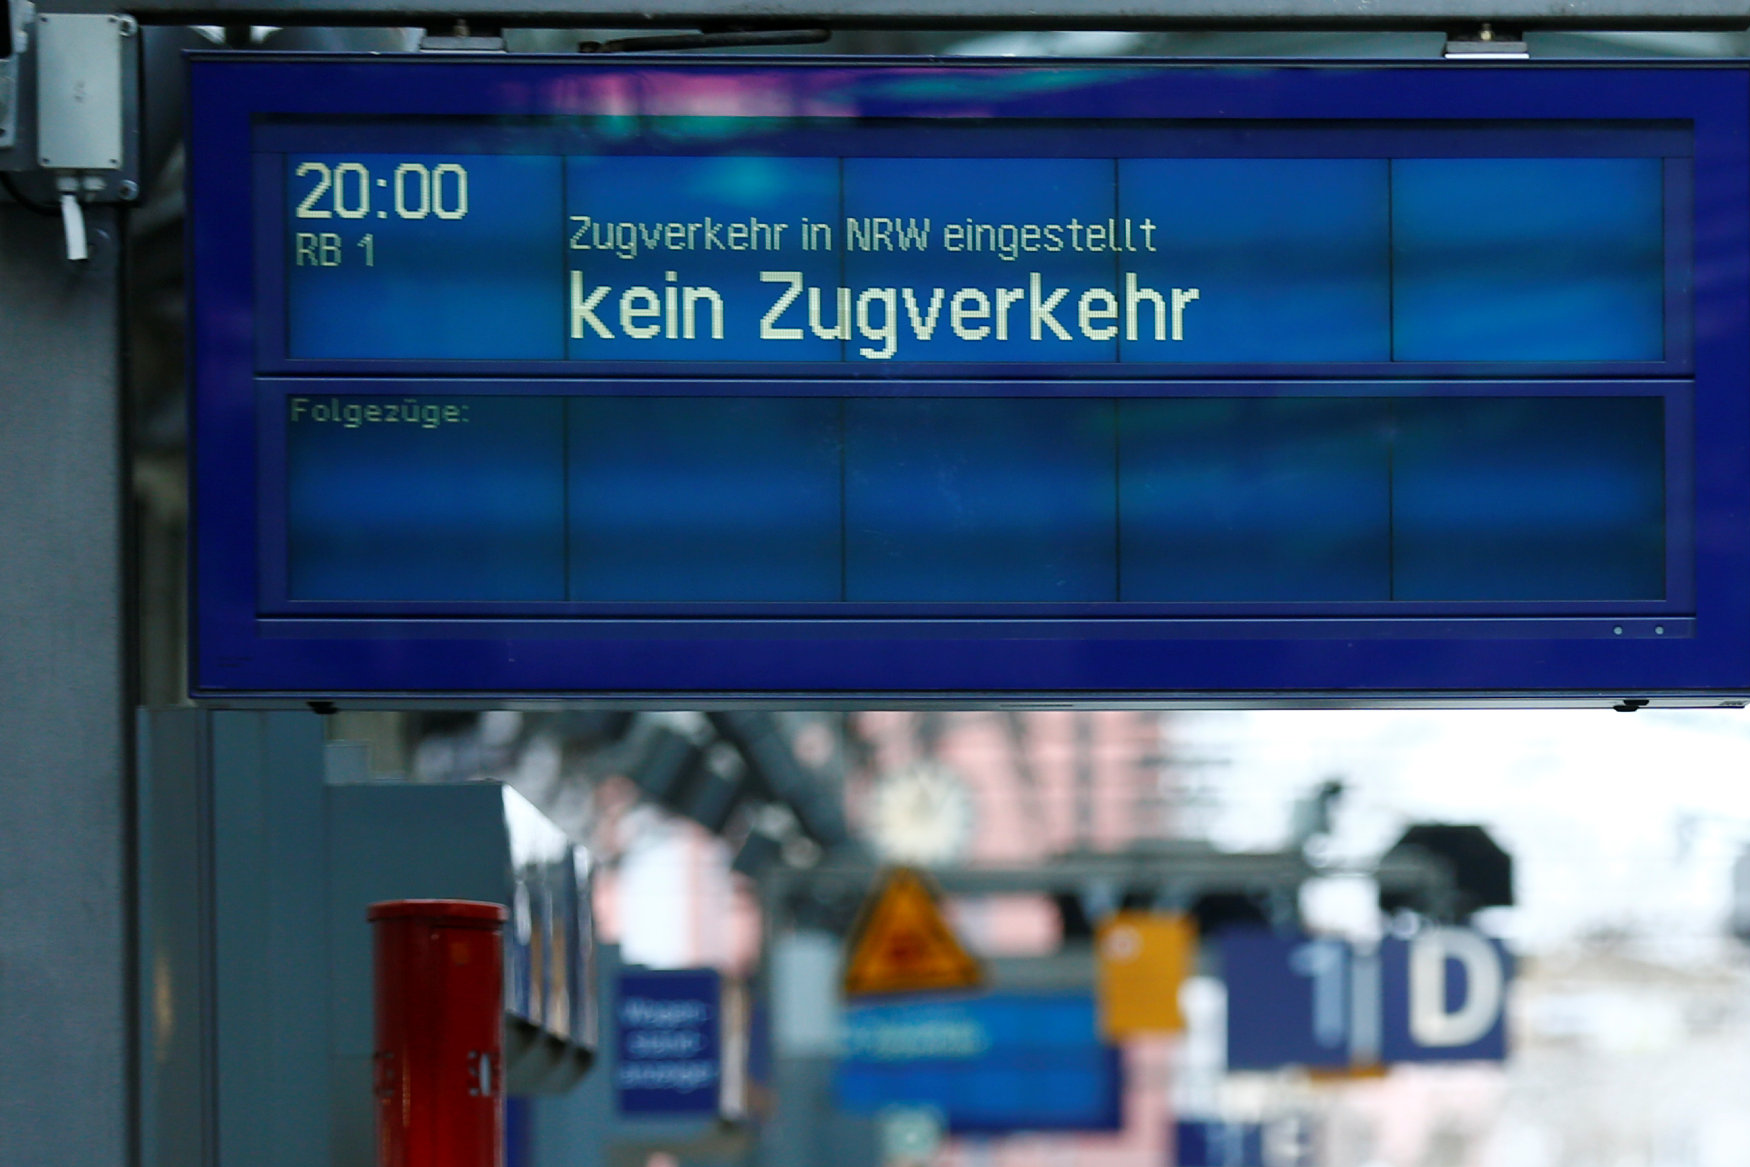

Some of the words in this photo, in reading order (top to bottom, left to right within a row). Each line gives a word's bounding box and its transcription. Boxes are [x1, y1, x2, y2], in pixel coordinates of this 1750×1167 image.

[296, 161, 468, 220] 20:00
[296, 232, 342, 267] RB
[357, 233, 374, 267] 1
[569, 215, 788, 260] Zugverkehr
[801, 217, 832, 251] in
[846, 217, 931, 251] NRW
[943, 217, 1158, 261] eingestellt
[570, 270, 725, 340] kein
[759, 270, 1200, 360] Zugverkehr
[292, 398, 469, 429] Folgezüge:
[1409, 926, 1505, 1047] D
